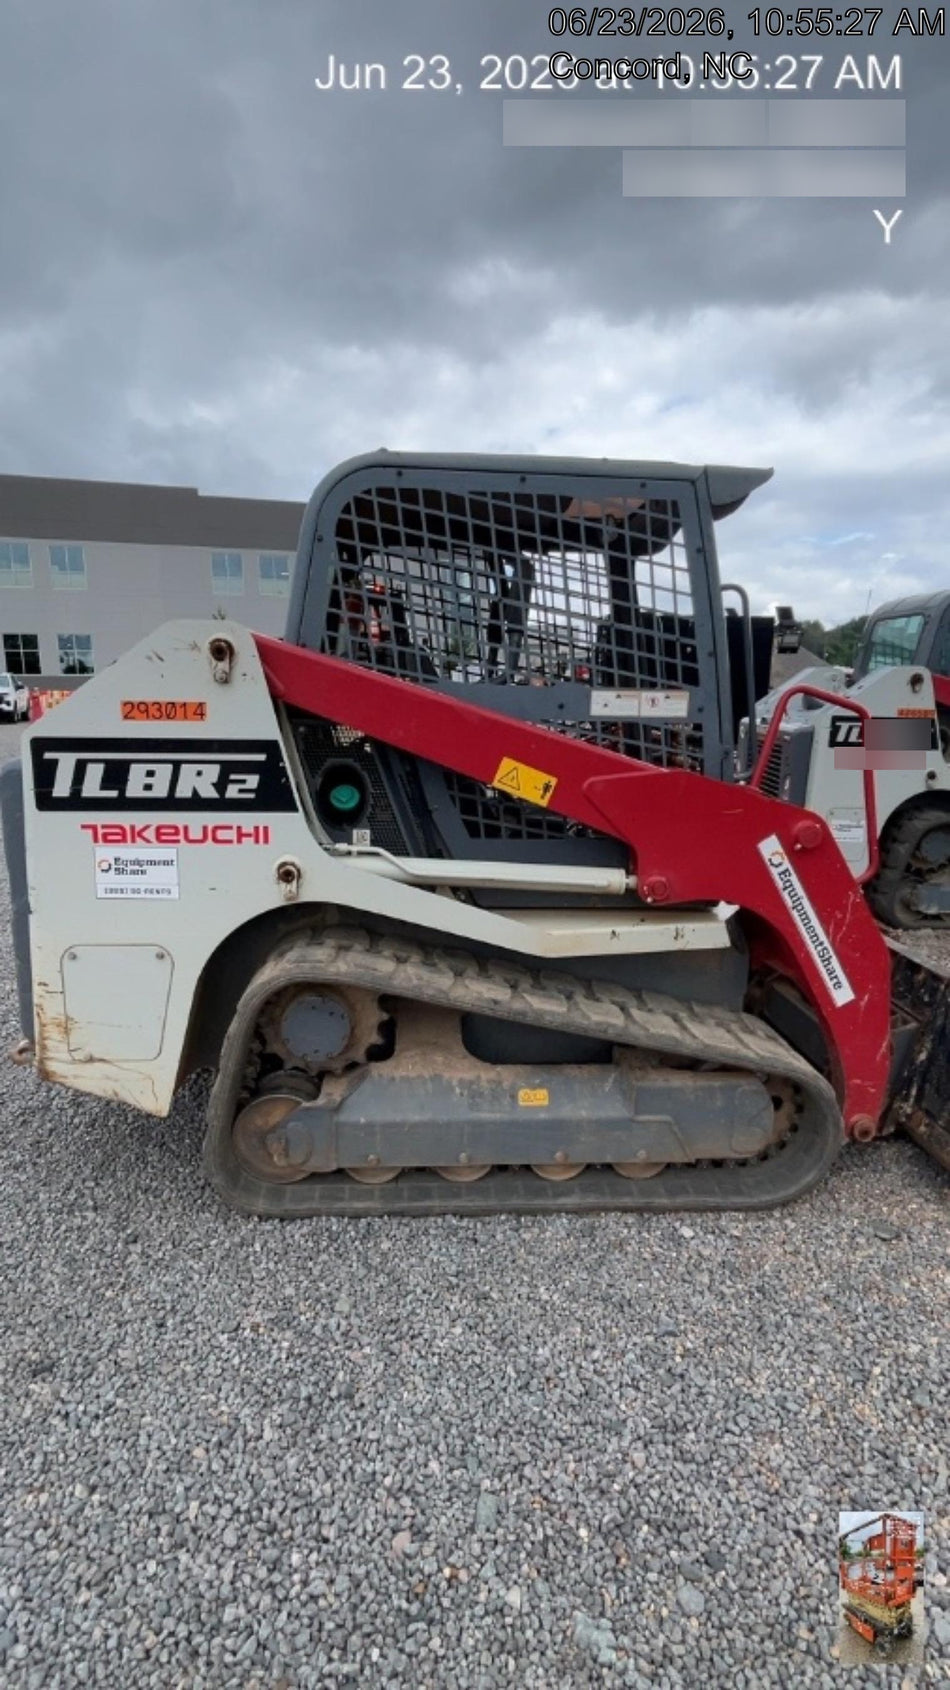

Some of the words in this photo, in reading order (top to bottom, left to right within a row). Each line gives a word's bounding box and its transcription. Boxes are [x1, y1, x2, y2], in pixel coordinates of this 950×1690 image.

[122, 701, 207, 720] 293014
[114, 857, 175, 868] Equipment
[114, 867, 147, 877] Share
[778, 868, 843, 990] EquipmentShare
